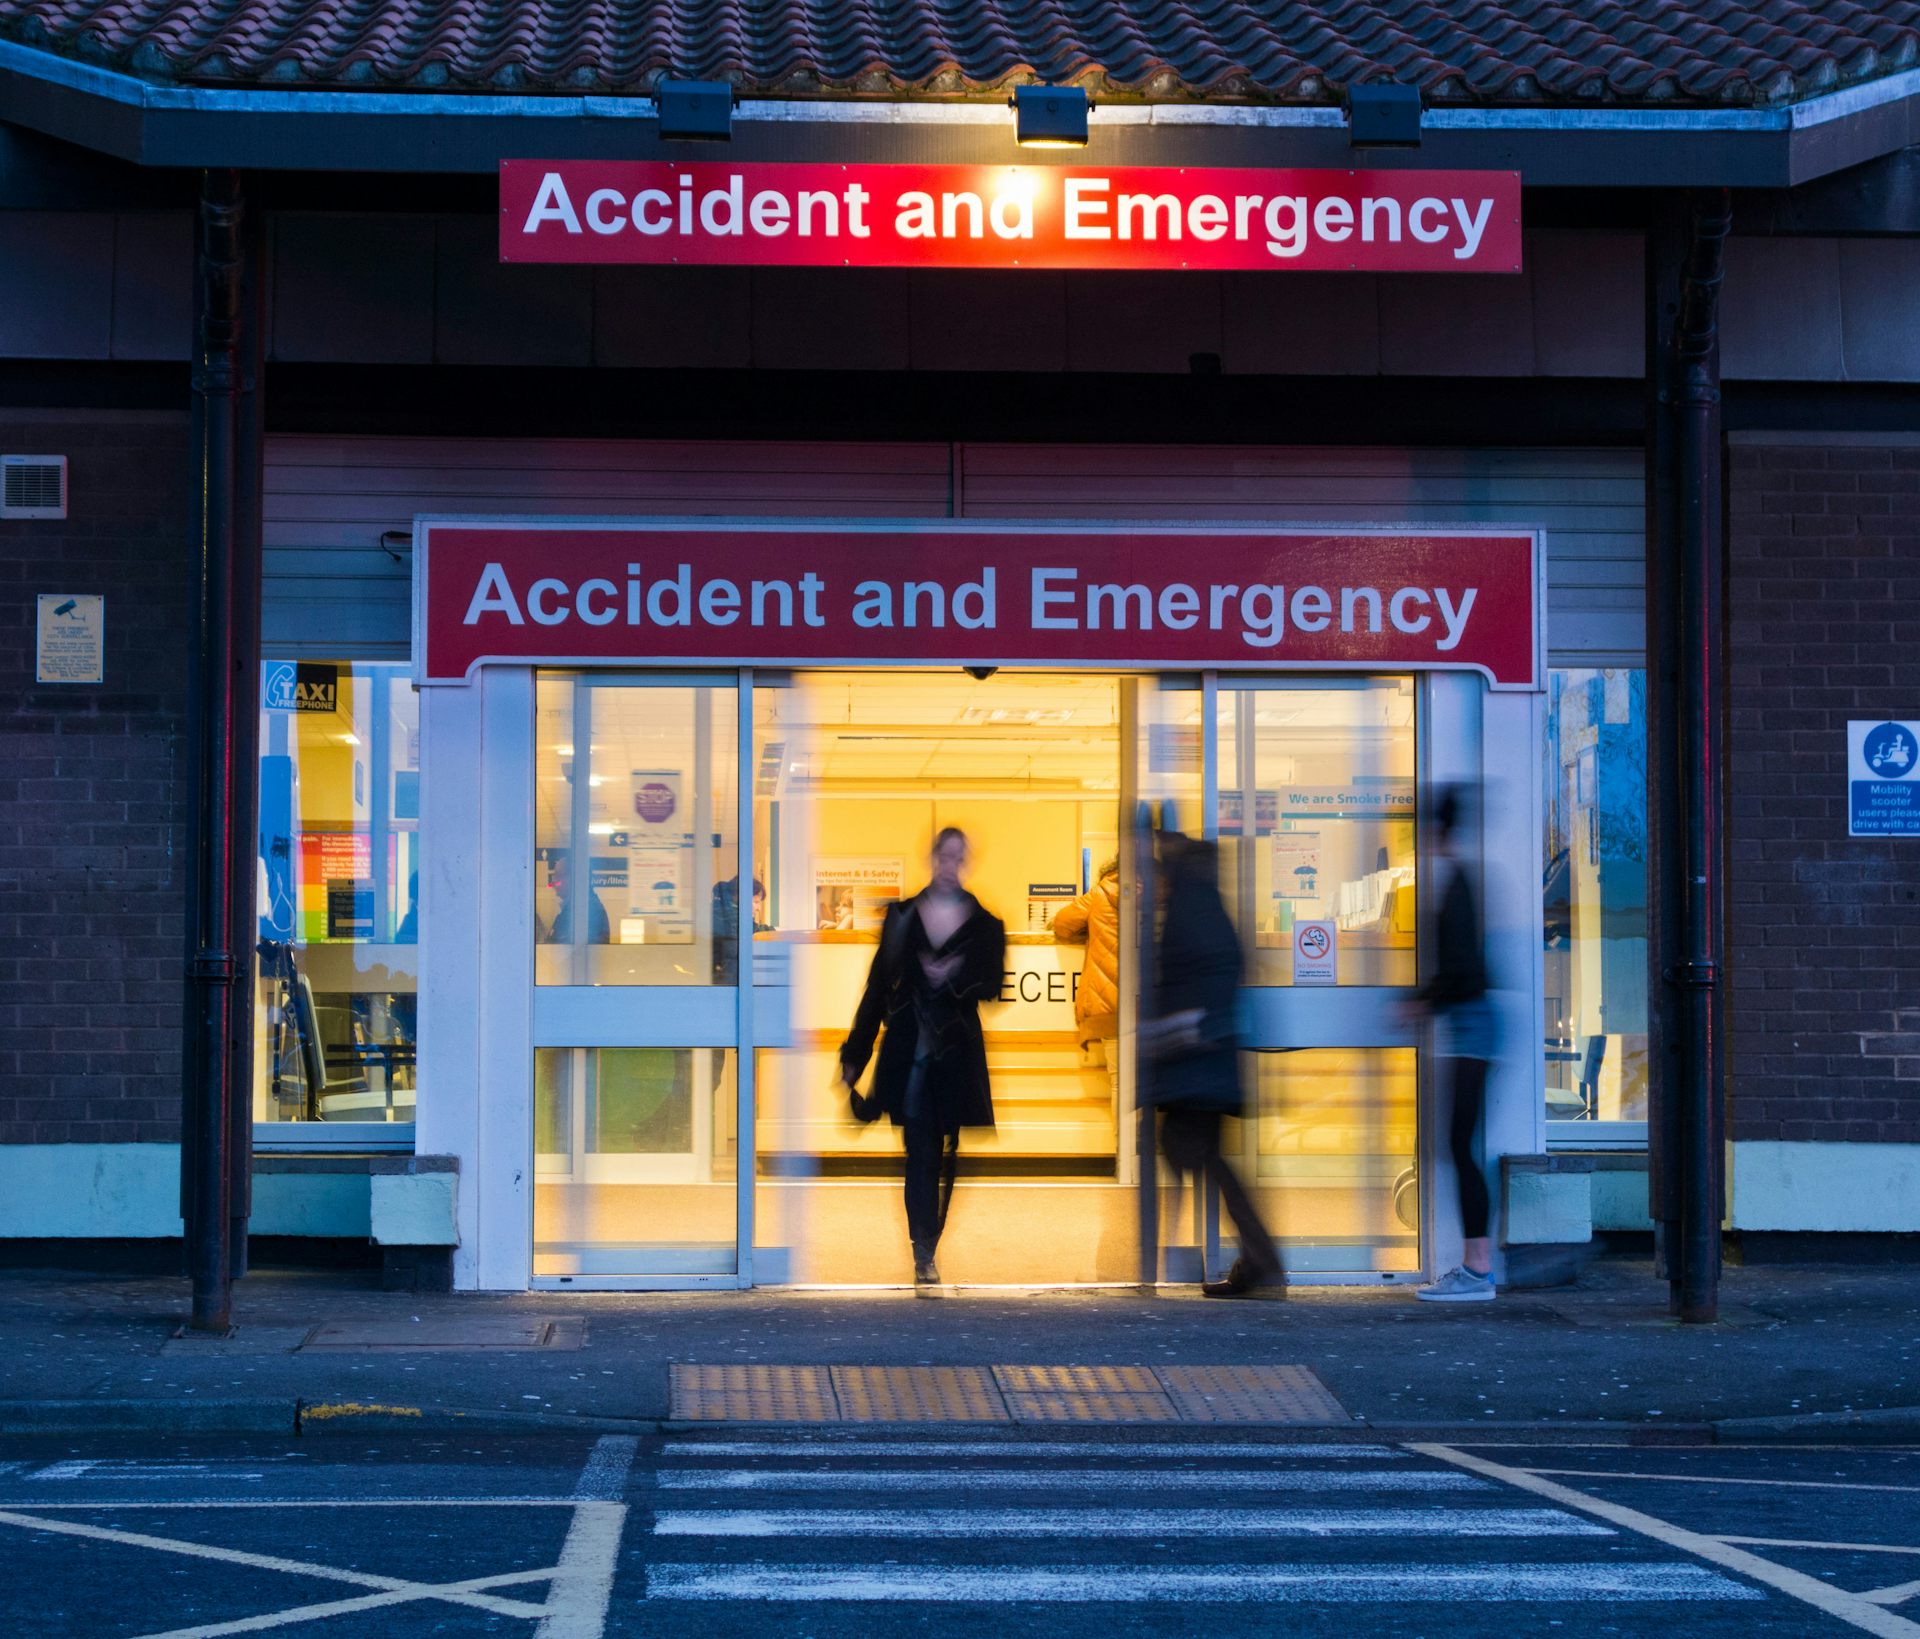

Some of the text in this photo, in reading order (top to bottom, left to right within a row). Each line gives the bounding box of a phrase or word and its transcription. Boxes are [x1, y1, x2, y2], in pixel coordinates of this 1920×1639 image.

[522, 172, 1495, 260] Accident and Emergency
[463, 563, 1478, 651] Accident and Emergency
[280, 681, 335, 702] TAXI
[278, 699, 334, 710] FREEPHONE
[1870, 785, 1912, 796] Mobility
[1288, 793, 1414, 805] We are Smoke Free
[1871, 797, 1912, 806] scooter
[1858, 809, 1887, 818] users
[1853, 819, 1920, 829] drive with ca
[815, 870, 852, 878] Internet
[863, 870, 900, 879] E-Safety
